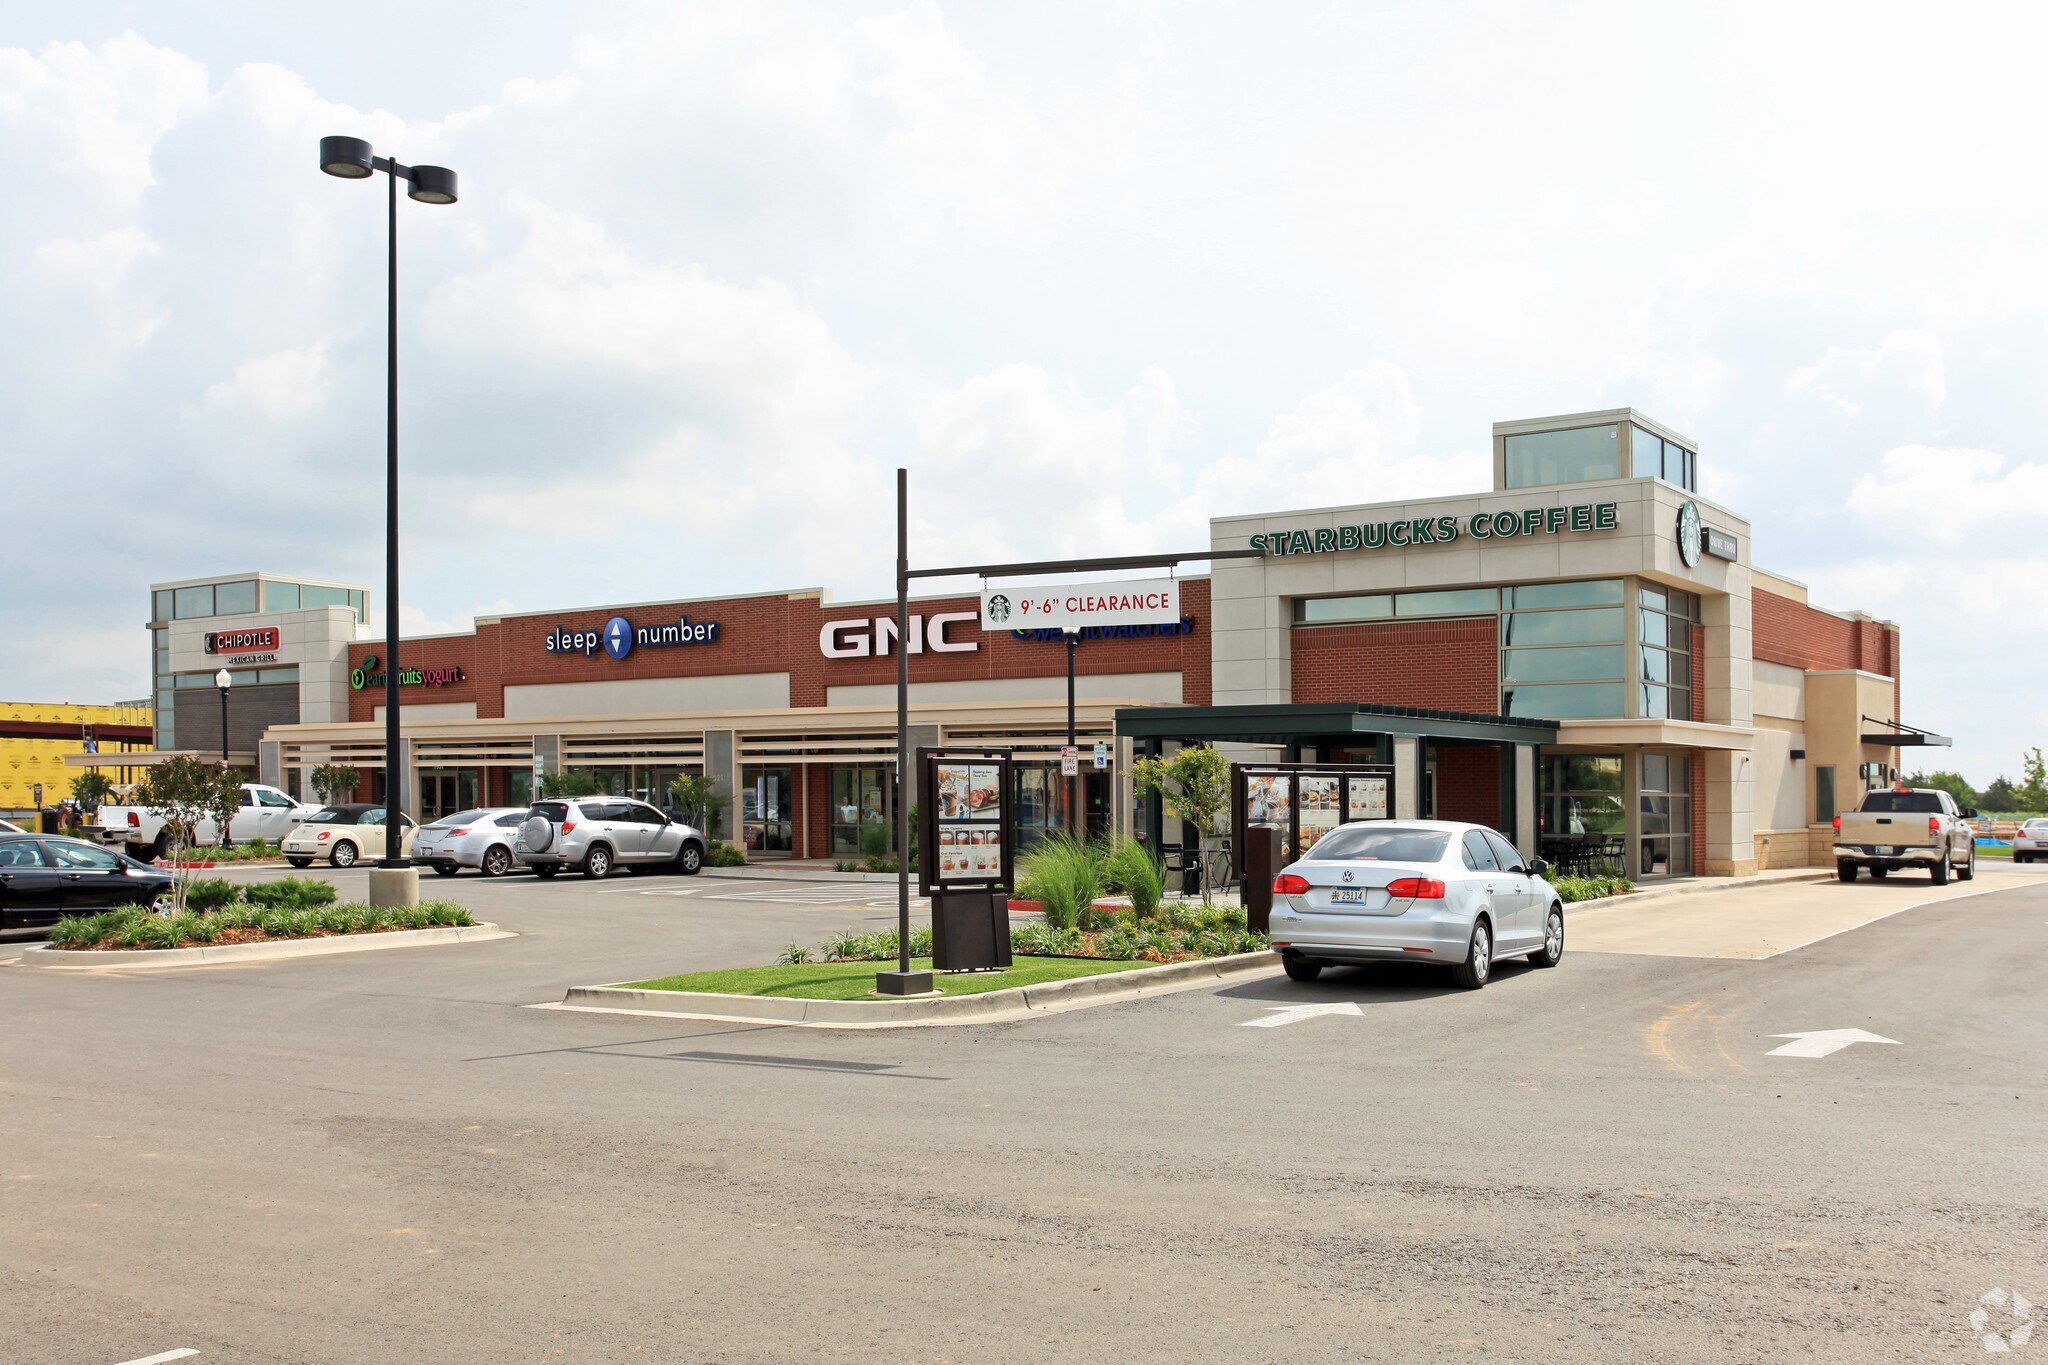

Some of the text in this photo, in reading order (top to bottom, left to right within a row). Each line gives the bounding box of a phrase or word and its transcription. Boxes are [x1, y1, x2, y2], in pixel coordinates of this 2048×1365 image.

[1249, 502, 1616, 557] STARBUCKS COFFEE
[1066, 593, 1169, 612] CLEARANCE
[217, 631, 272, 649] CHIPOTLE
[546, 618, 715, 655] sleep number
[819, 611, 978, 659] GNC
[228, 654, 277, 664] MEXICAN GRILL
[1341, 891, 1362, 900] 25114
